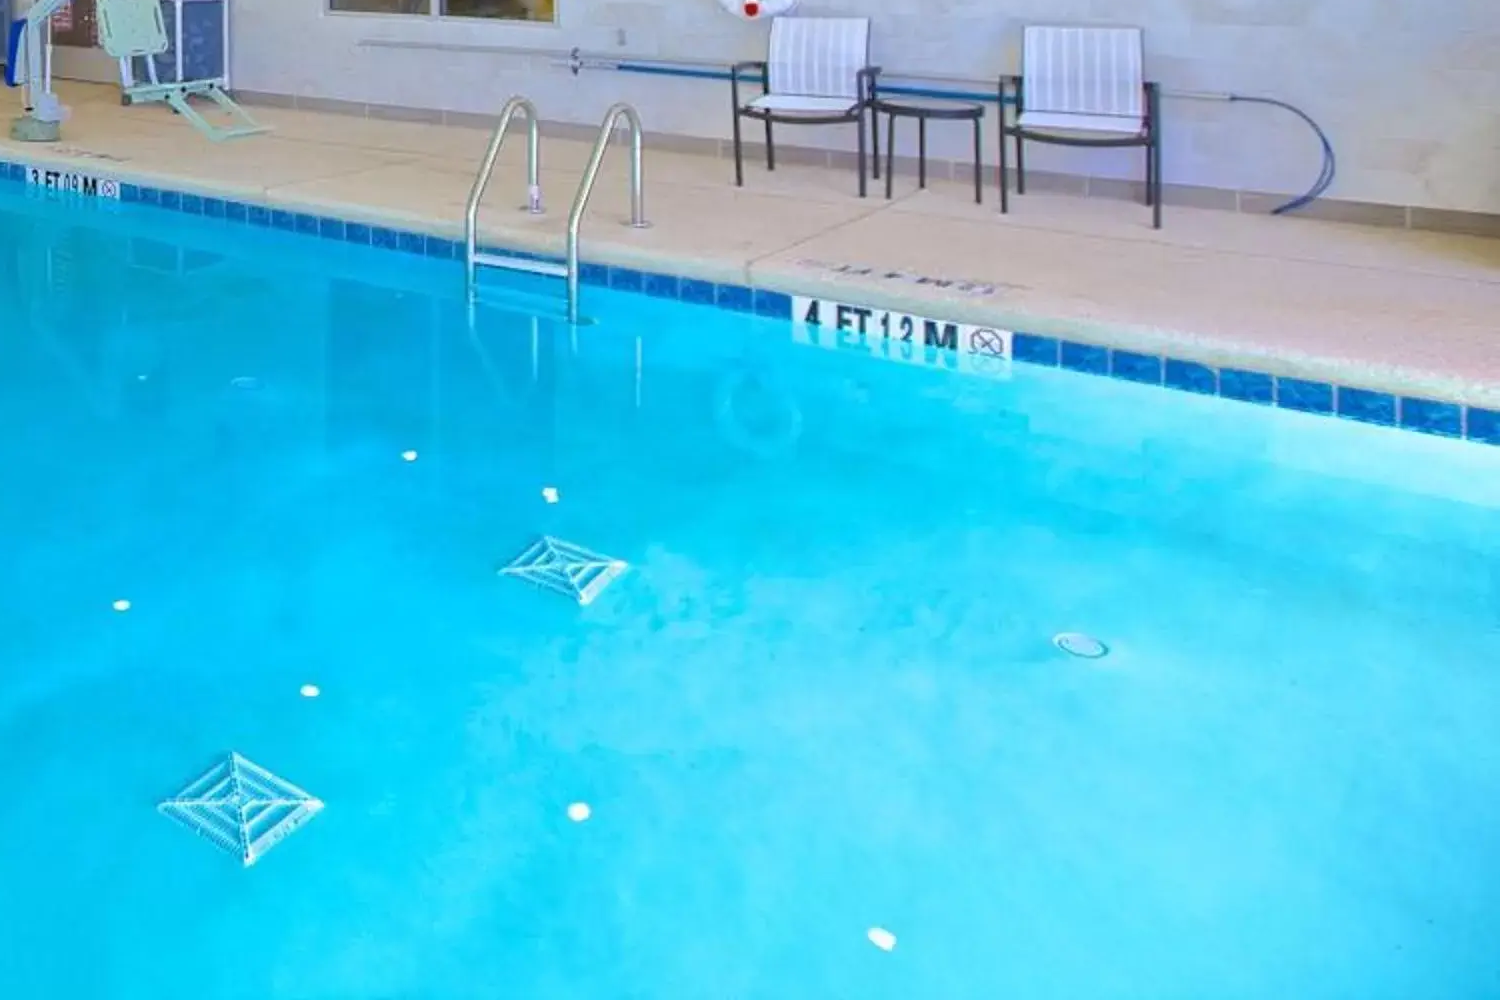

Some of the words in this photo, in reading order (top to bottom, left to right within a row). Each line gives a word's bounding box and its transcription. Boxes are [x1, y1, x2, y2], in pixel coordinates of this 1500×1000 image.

[45, 170, 61, 192] FT
[83, 175, 98, 197] M
[804, 299, 822, 326] 4
[836, 304, 873, 335] FT
[923, 320, 959, 350] M
